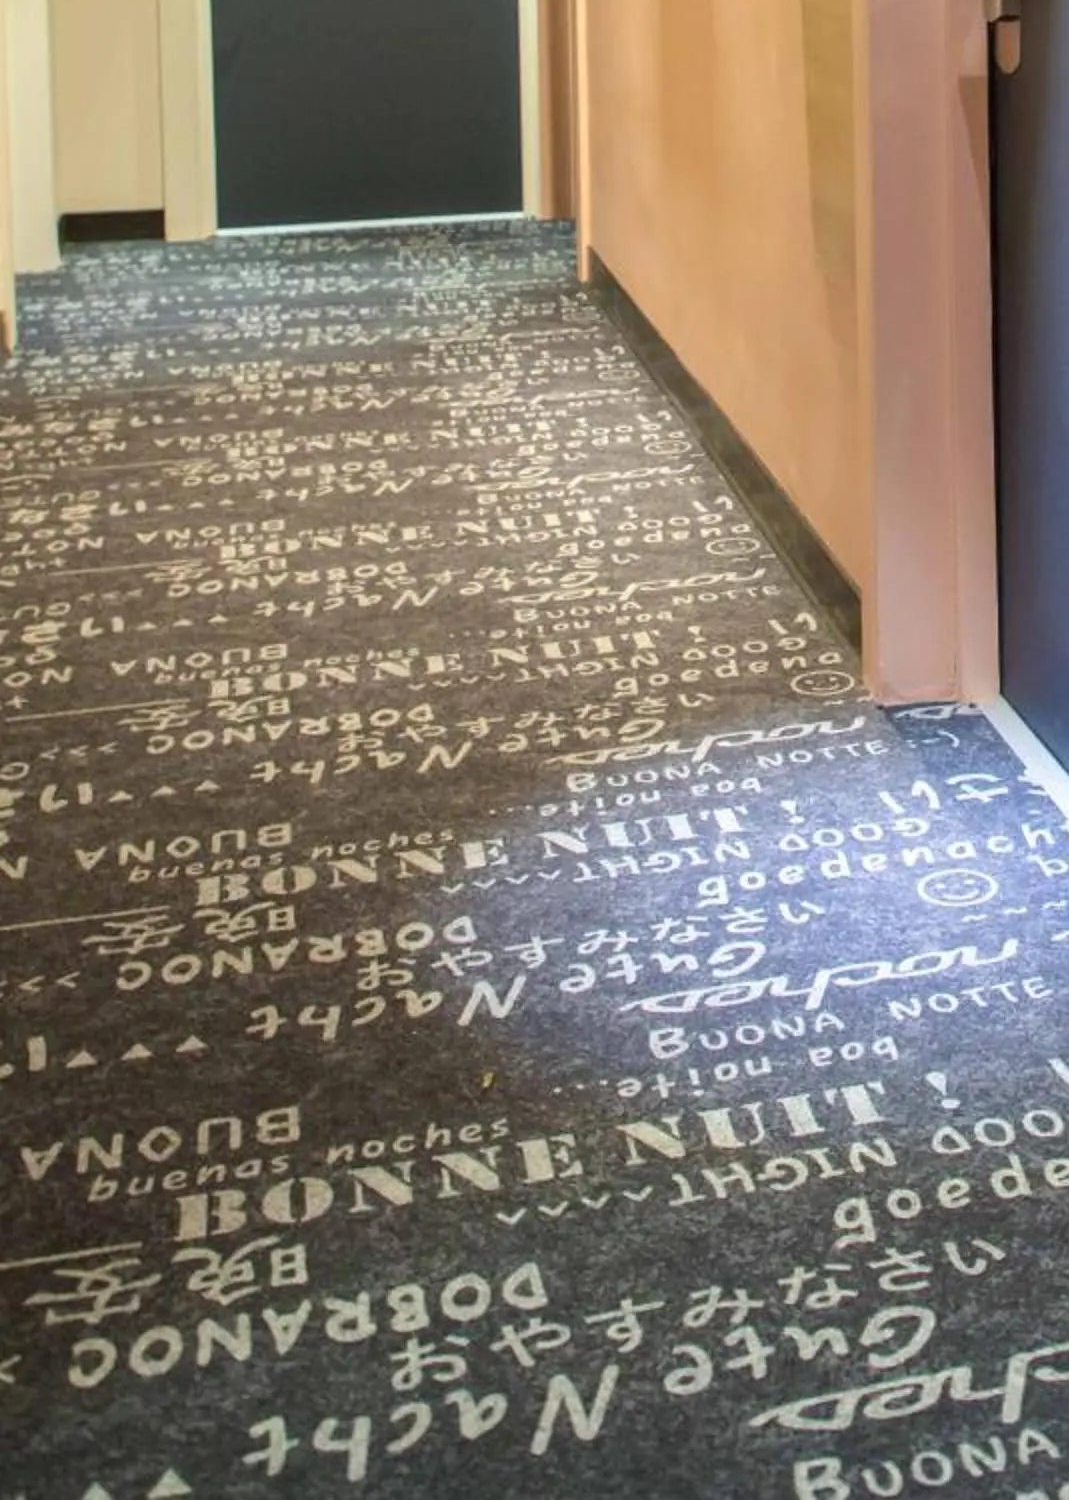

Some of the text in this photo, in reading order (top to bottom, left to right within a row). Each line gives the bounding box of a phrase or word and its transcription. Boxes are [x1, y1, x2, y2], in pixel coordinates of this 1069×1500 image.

[75, 823, 292, 871] BUONA
[128, 828, 455, 883] buenas noches
[197, 839, 508, 906] BONNE
[539, 805, 749, 859] NUIT
[573, 817, 929, 884] GOOD NIGHT
[116, 915, 478, 990] DOBRANOC
[246, 941, 767, 1042] Gute Nacht
[648, 976, 1051, 1060] BUONA NOTTE
[808, 1036, 899, 1064] boa
[19, 1105, 302, 1181] BUONA
[88, 1117, 510, 1202] buenas noches
[174, 1134, 584, 1241] BONNE
[618, 1082, 886, 1167] NUIT
[669, 1138, 897, 1205] NIGHT
[68, 1261, 548, 1388] DOBRANOC
[243, 1305, 937, 1482] Gute Nacht
[793, 1428, 1063, 1500] BUONA
